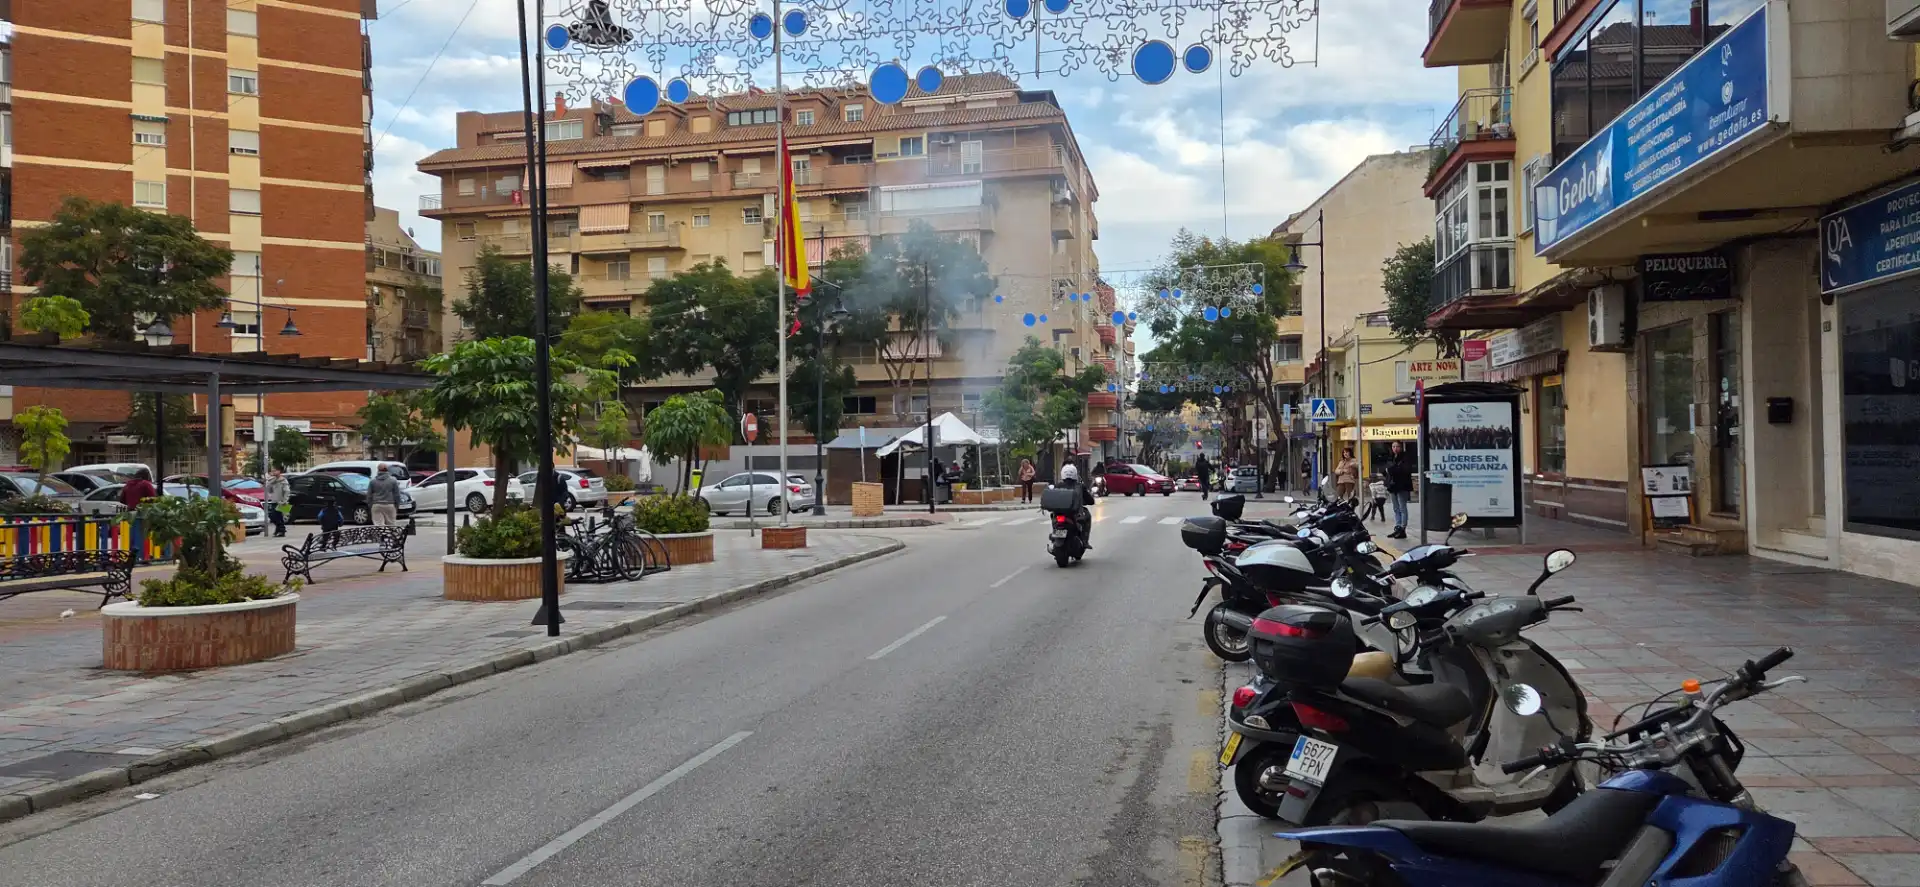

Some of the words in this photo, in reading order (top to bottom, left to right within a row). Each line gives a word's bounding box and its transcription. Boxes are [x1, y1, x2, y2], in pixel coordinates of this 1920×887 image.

[1656, 81, 1685, 108] AUTOMÓVIL
[1652, 97, 1686, 128] EXTRANJERÍA
[1697, 108, 1762, 154] www.gedofu.es
[1652, 157, 1681, 181] GENERALES
[1560, 150, 1609, 215] Gedof
[1880, 219, 1901, 235] PARA
[1410, 362, 1433, 372] ARTE
[1436, 361, 1458, 371] NOVA
[1434, 463, 1446, 471] TU
[1449, 463, 1508, 471] CONFIANZA
[1442, 454, 1483, 463] LÍDERES
[1485, 455, 1499, 463] EN
[1303, 741, 1334, 761] 6677
[1300, 757, 1324, 776] FPN
